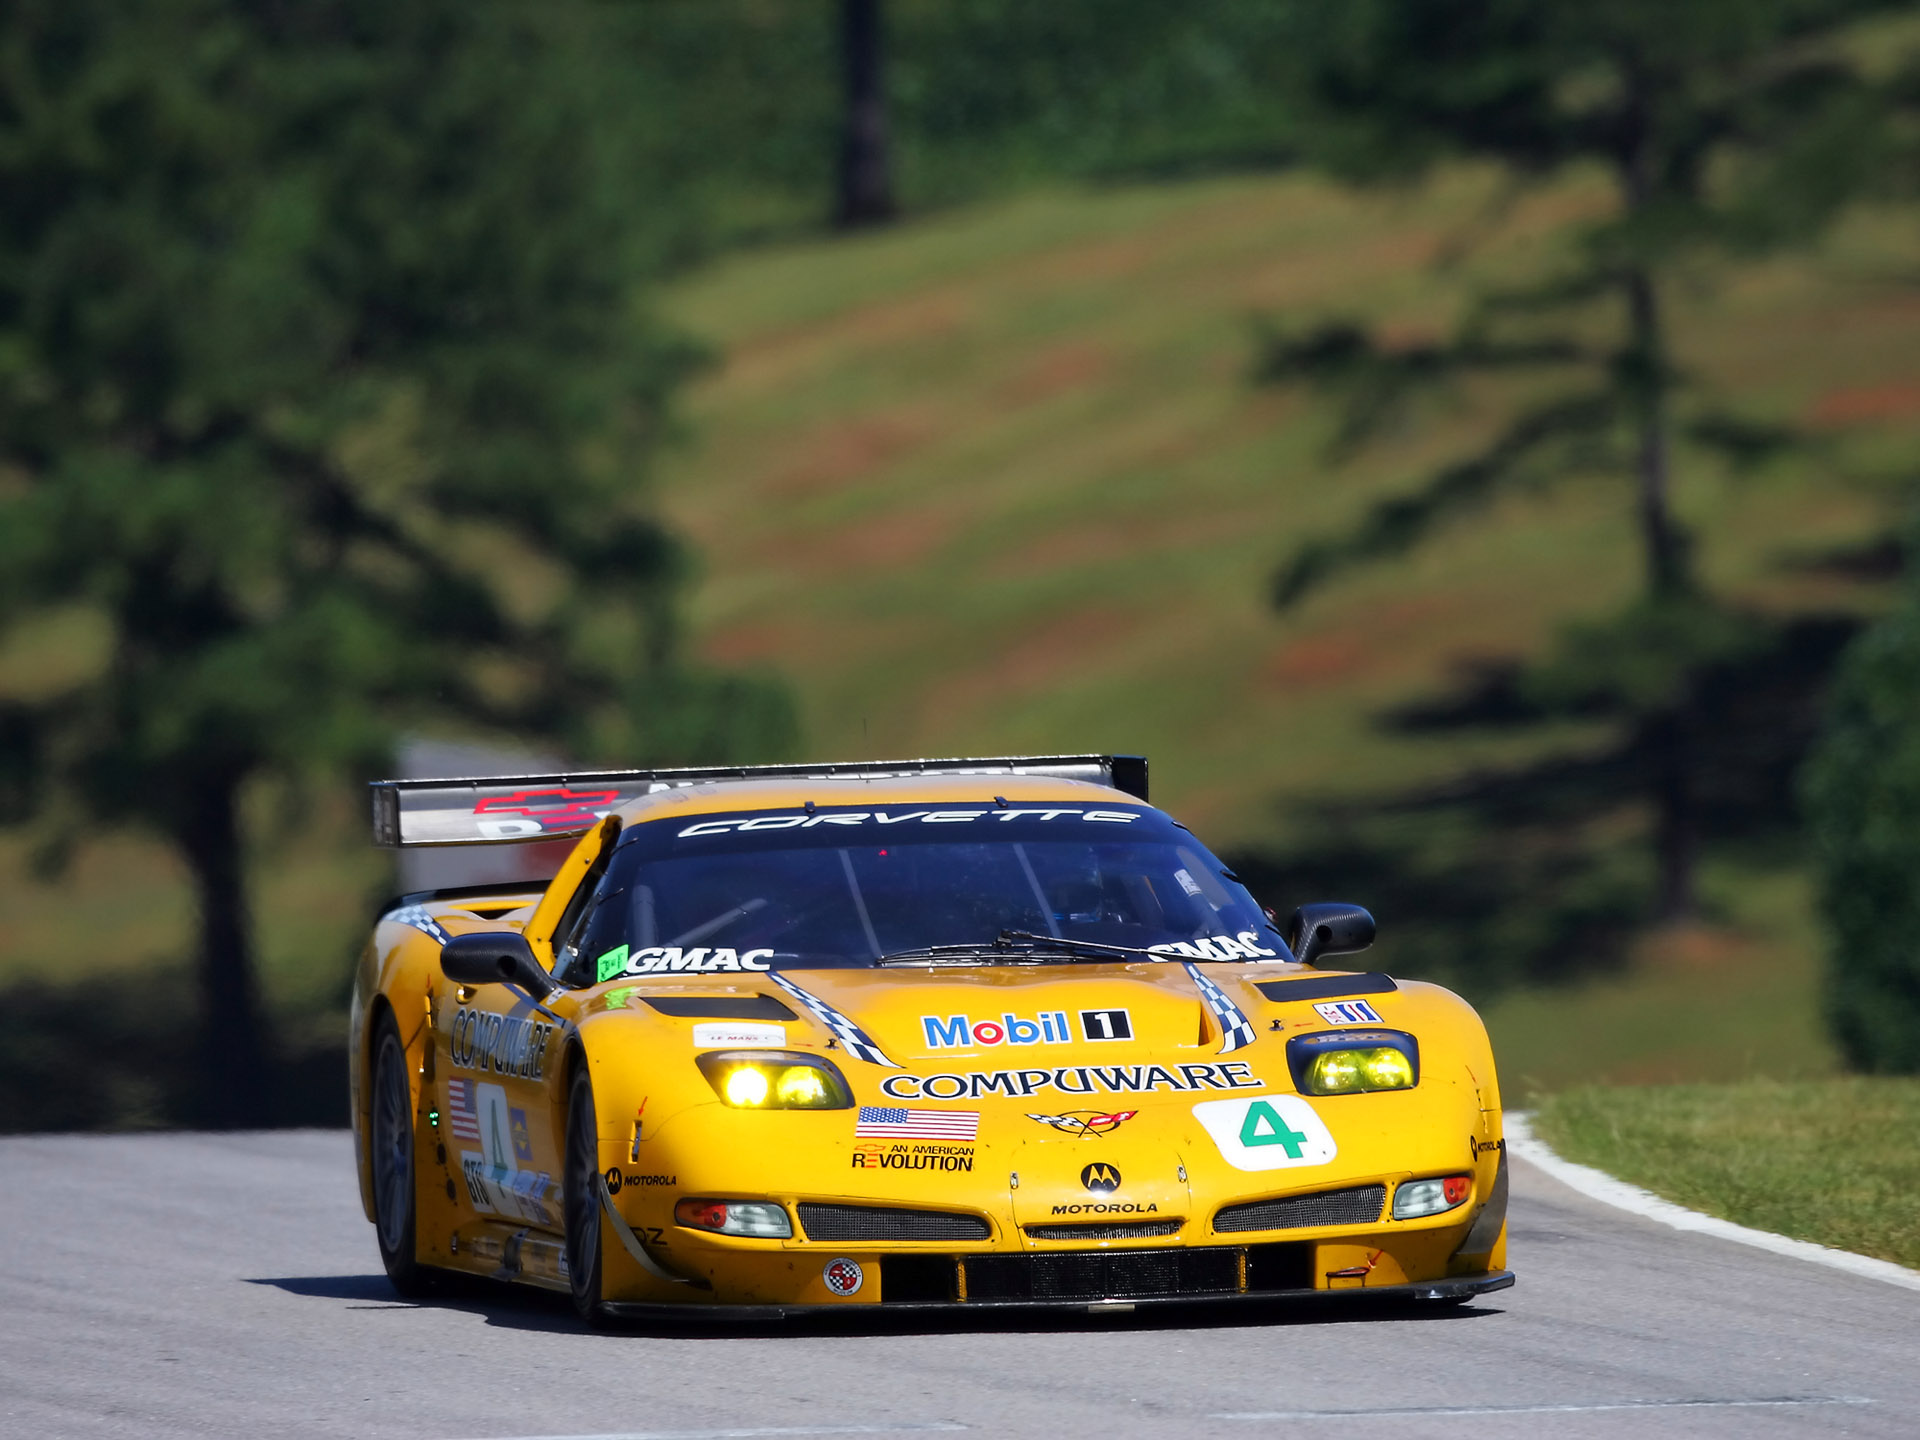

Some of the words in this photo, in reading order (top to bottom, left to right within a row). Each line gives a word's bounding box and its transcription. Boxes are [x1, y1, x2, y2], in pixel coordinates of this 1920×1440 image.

[678, 809, 1141, 837] CORVETTE
[626, 947, 774, 973] GMAC
[924, 1013, 1071, 1046] Mobil
[451, 1008, 552, 1081] COMPUWARE
[881, 1062, 1263, 1099] COMPUWARE
[1239, 1101, 1308, 1159] 4
[852, 1153, 973, 1172] REVOLUTION
[891, 1144, 908, 1153] AN
[912, 1145, 974, 1156] AMERICAN
[624, 1175, 677, 1186] MOTOROLA
[1051, 1203, 1158, 1215] MOTOROLA
